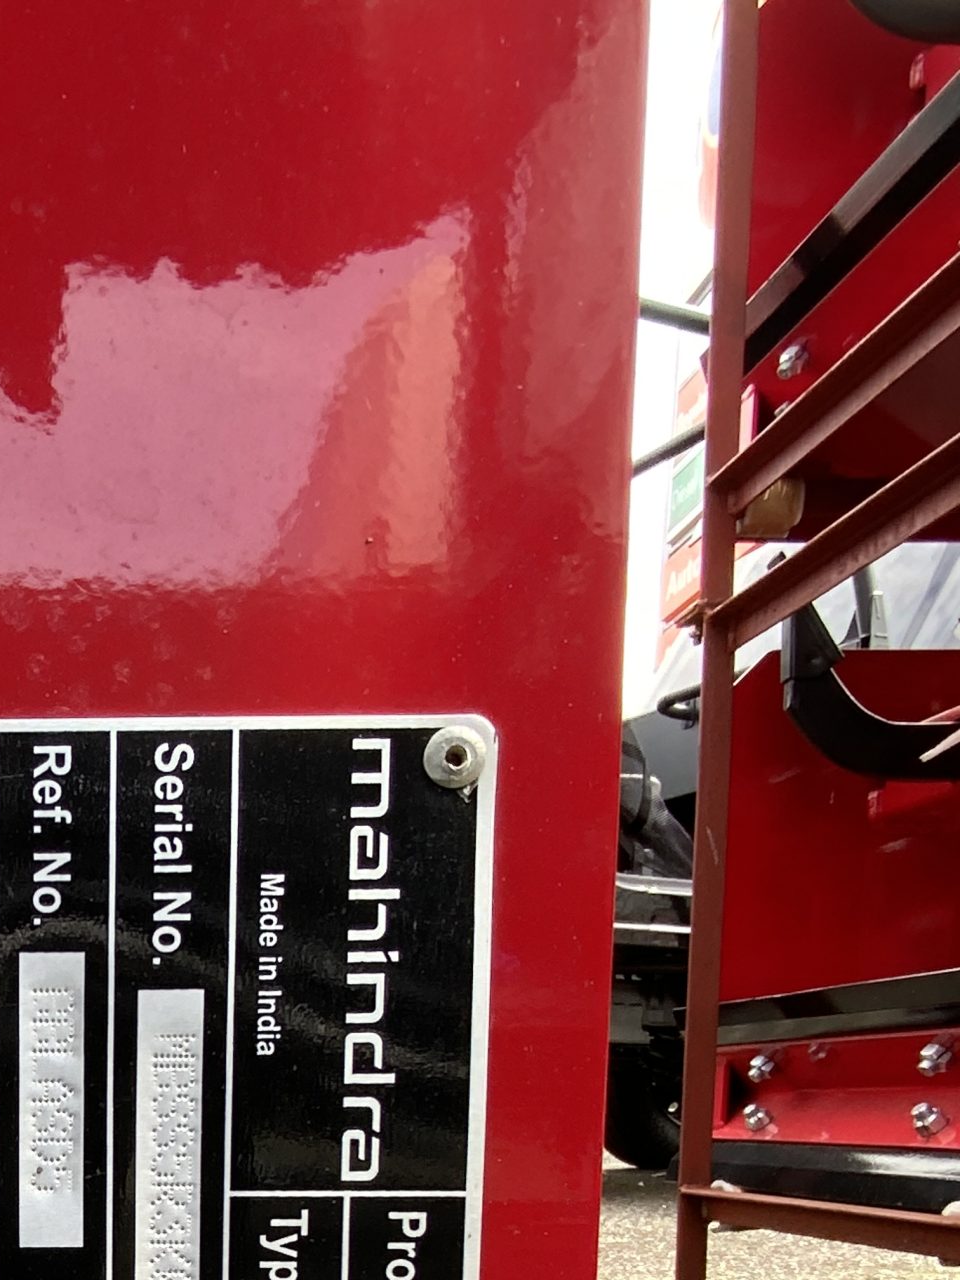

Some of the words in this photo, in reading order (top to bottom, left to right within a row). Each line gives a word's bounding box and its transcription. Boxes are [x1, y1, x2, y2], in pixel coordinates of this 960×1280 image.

[33, 745, 72, 833] Ref.
[154, 743, 194, 873] Serial
[33, 853, 71, 925] No.
[259, 874, 285, 946] Made
[152, 892, 191, 965] No.
[341, 738, 400, 1181] mahindra
[259, 957, 282, 980] in
[257, 991, 282, 1055] India
[30, 986, 75, 1193] BBLASD5
